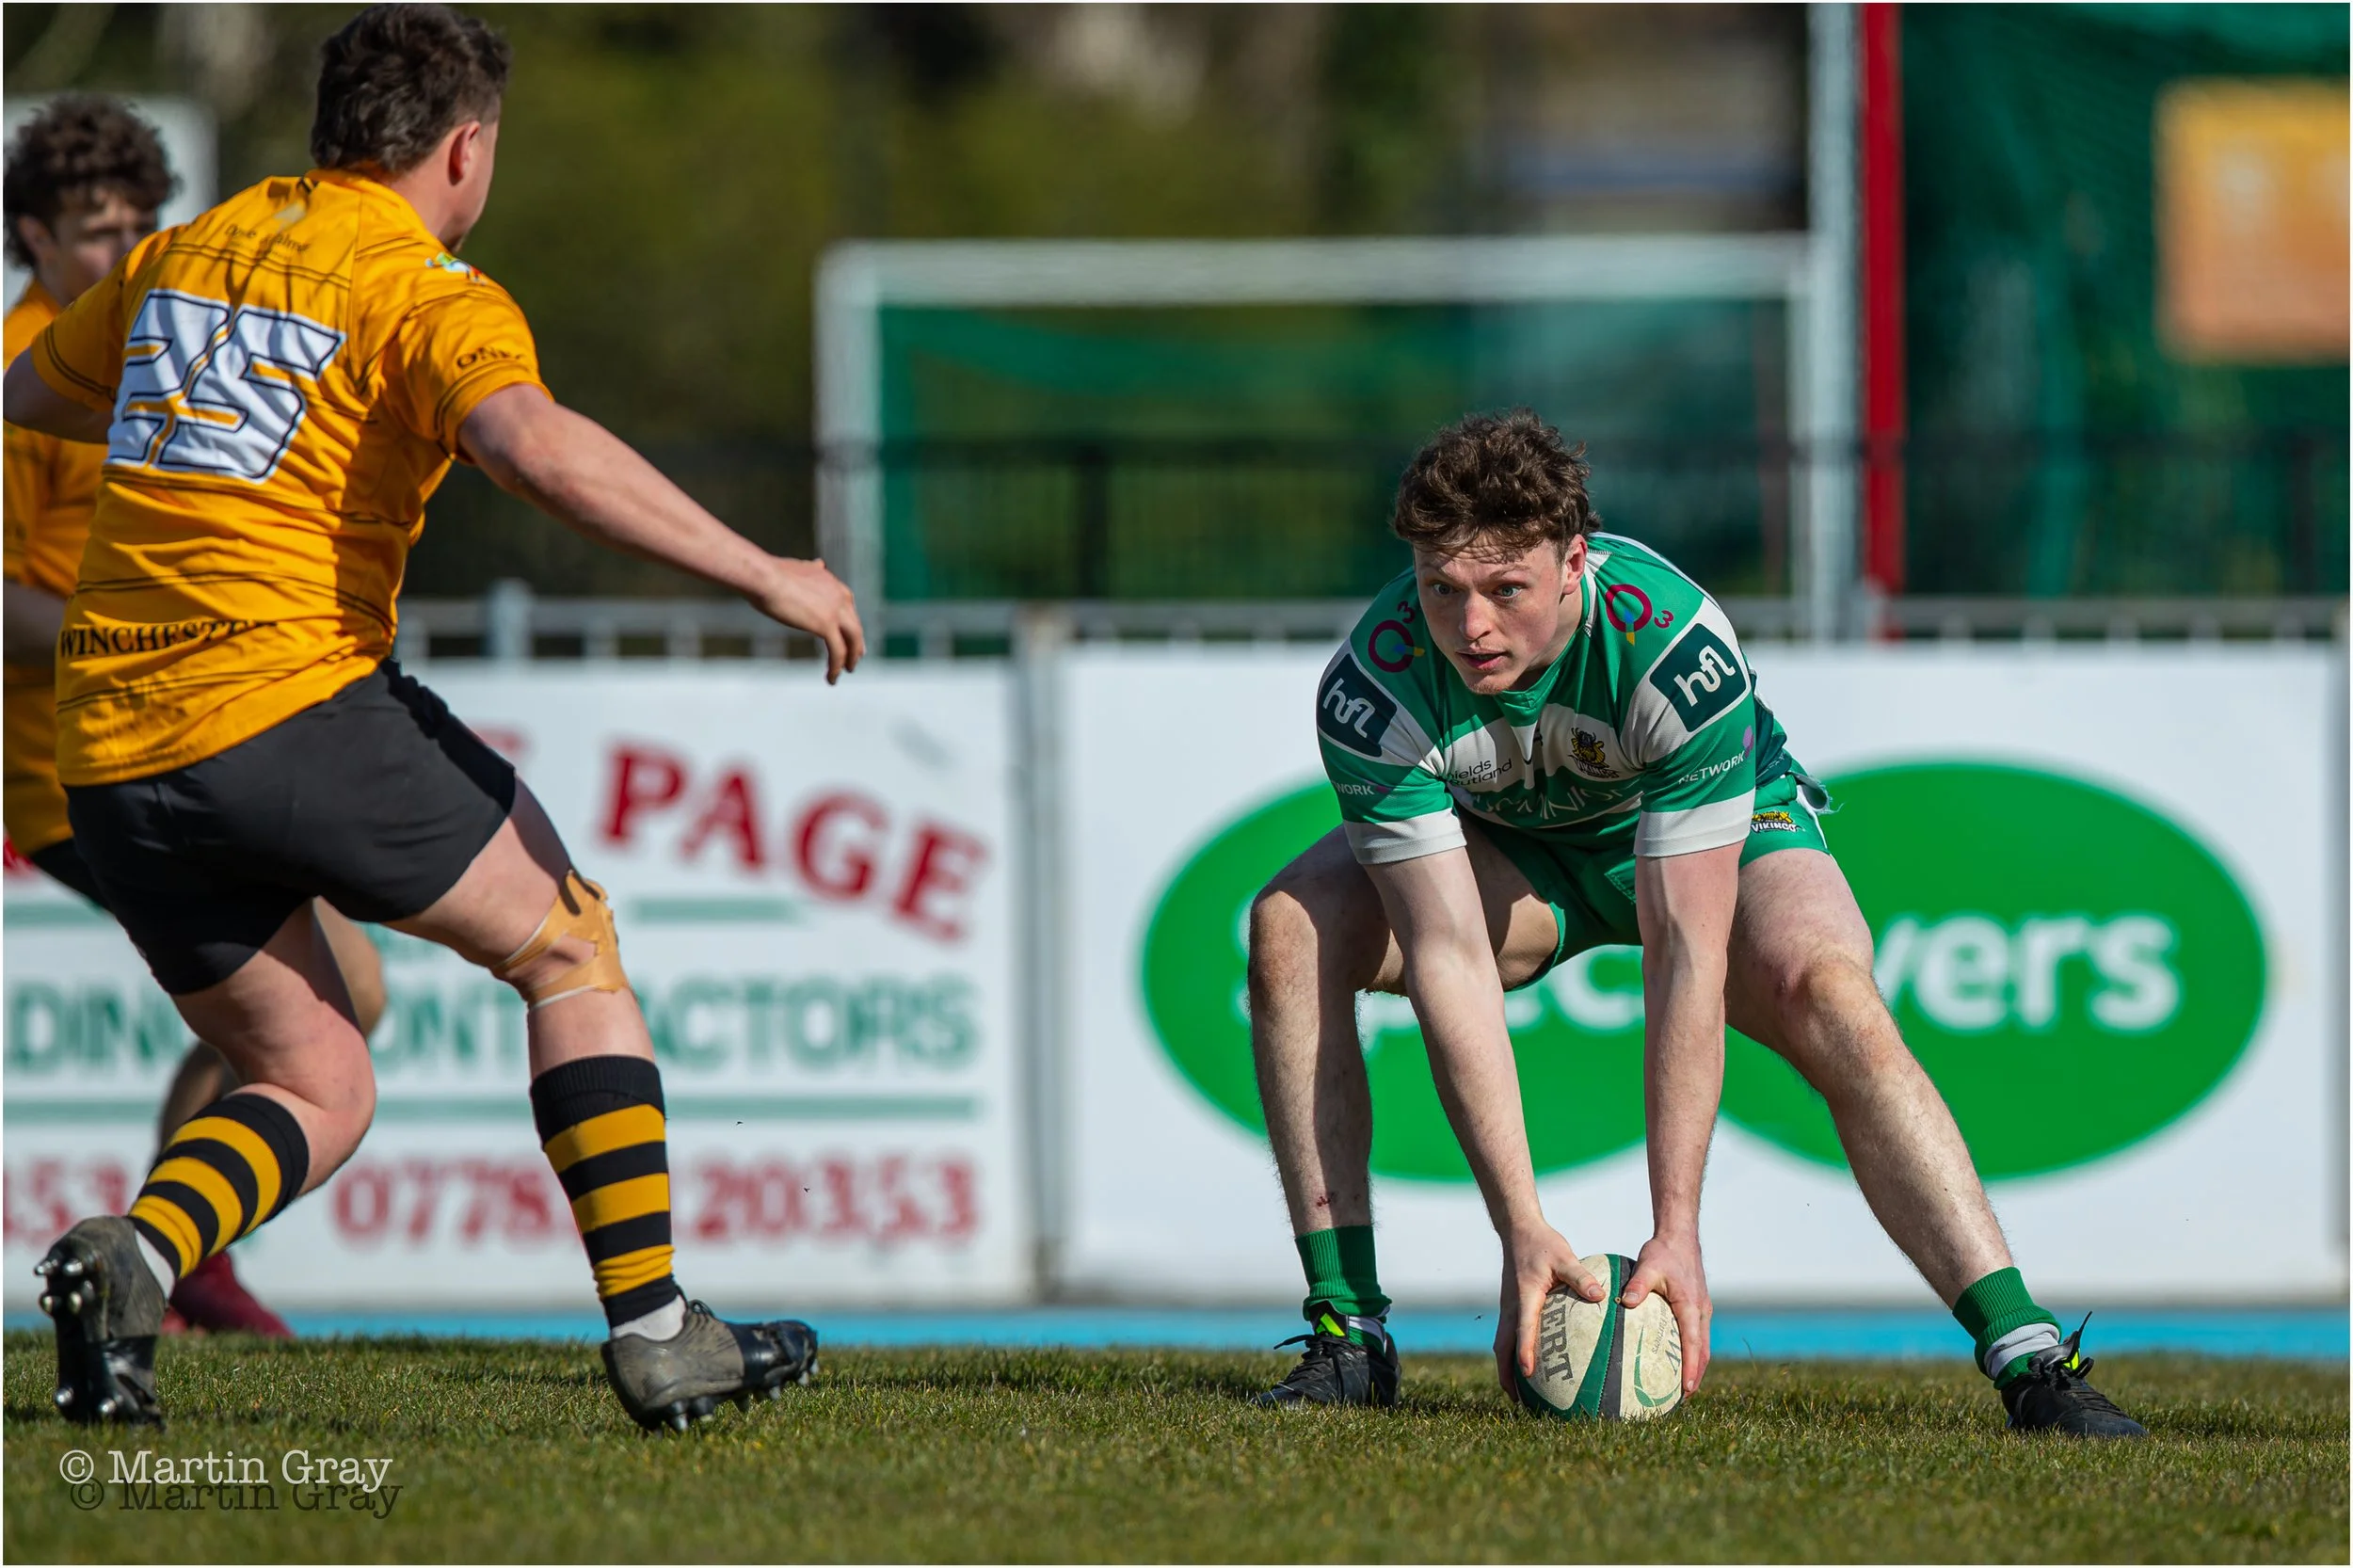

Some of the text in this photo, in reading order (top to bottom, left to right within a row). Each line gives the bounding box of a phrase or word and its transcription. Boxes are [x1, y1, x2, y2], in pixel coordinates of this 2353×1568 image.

[104, 288, 346, 484] 25
[1332, 780, 1375, 796] WORK
[1678, 749, 1746, 785] NETWORK
[602, 737, 986, 944] PAGE
